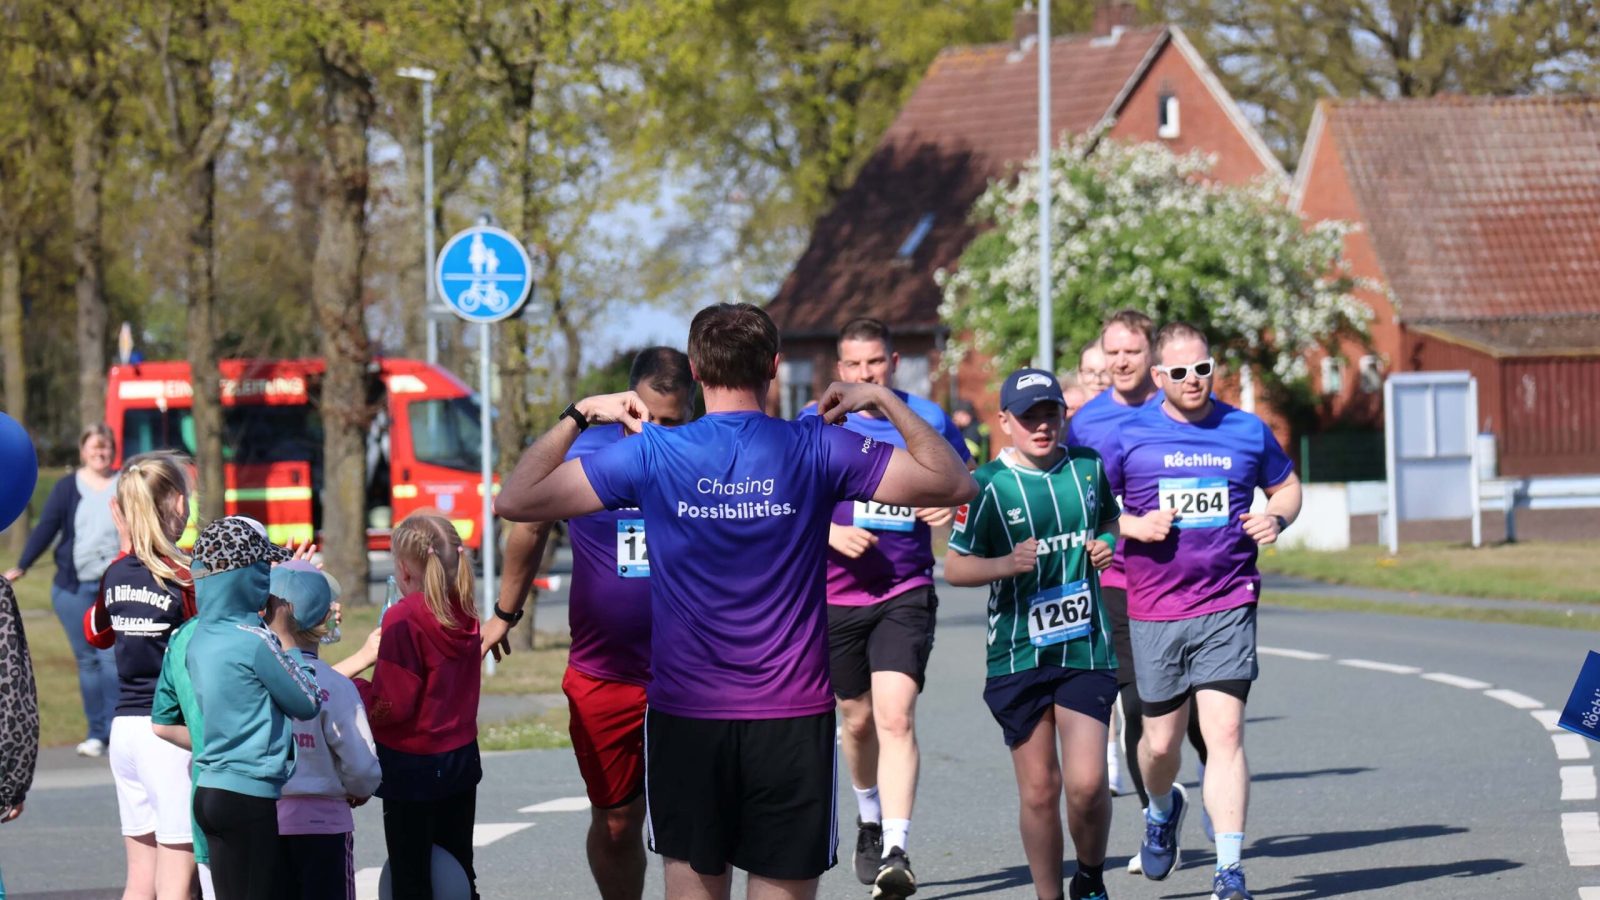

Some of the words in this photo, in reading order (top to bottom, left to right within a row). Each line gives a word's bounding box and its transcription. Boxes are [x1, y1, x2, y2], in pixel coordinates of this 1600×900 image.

[1163, 451, 1232, 470] Röchling
[697, 476, 774, 496] Chasing
[677, 500, 797, 519] Possibilities.
[1166, 491, 1223, 513] 1264
[114, 585, 172, 611] Rütenbrock
[1032, 596, 1091, 631] 1262
